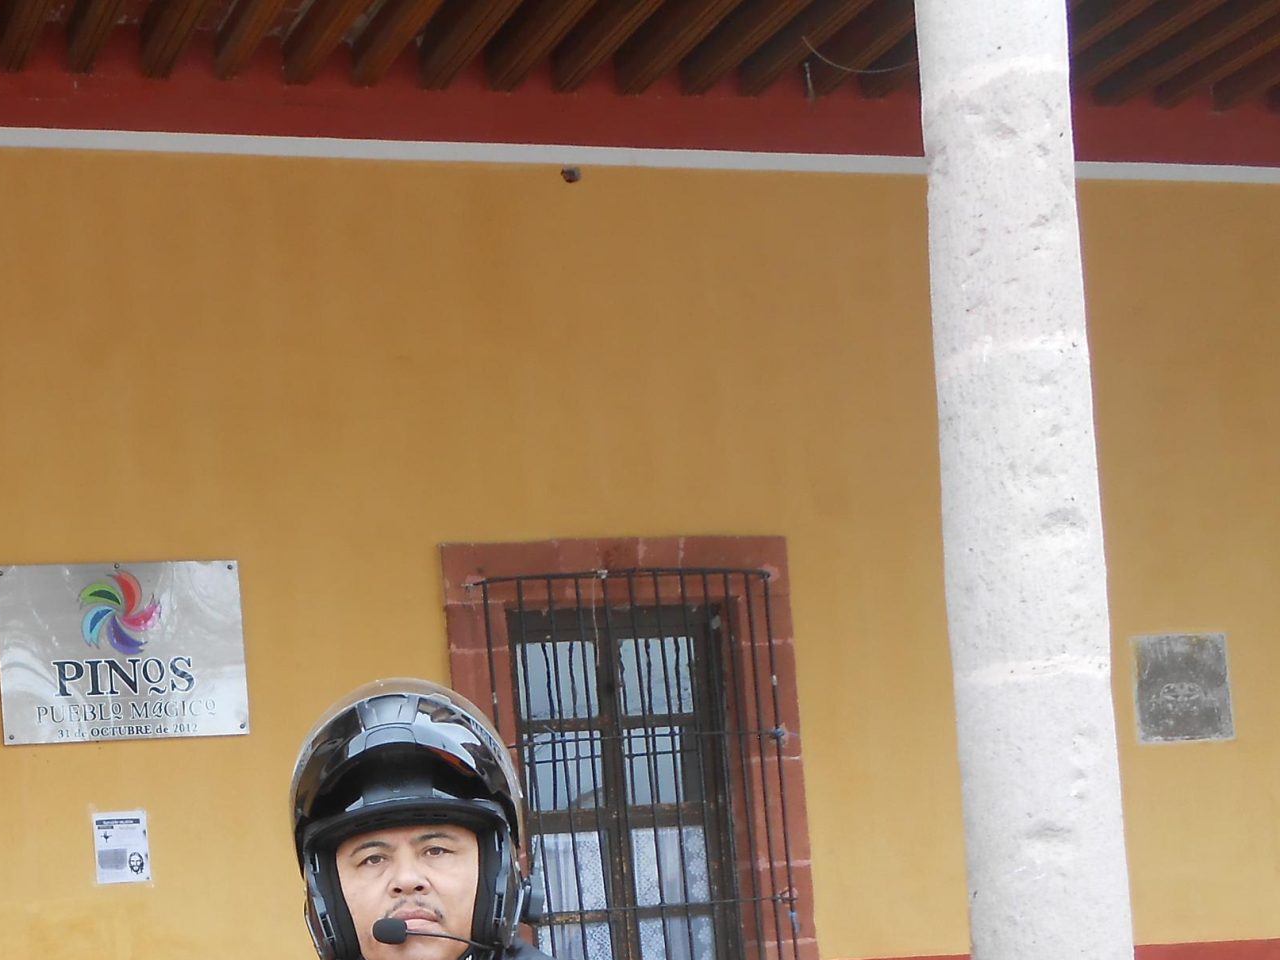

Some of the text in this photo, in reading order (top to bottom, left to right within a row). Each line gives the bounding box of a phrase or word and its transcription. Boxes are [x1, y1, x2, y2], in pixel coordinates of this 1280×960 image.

[52, 656, 195, 697] PINOS
[36, 701, 123, 724] PUEBLO
[57, 723, 198, 739] 31 de OCTUBRE de 2012
